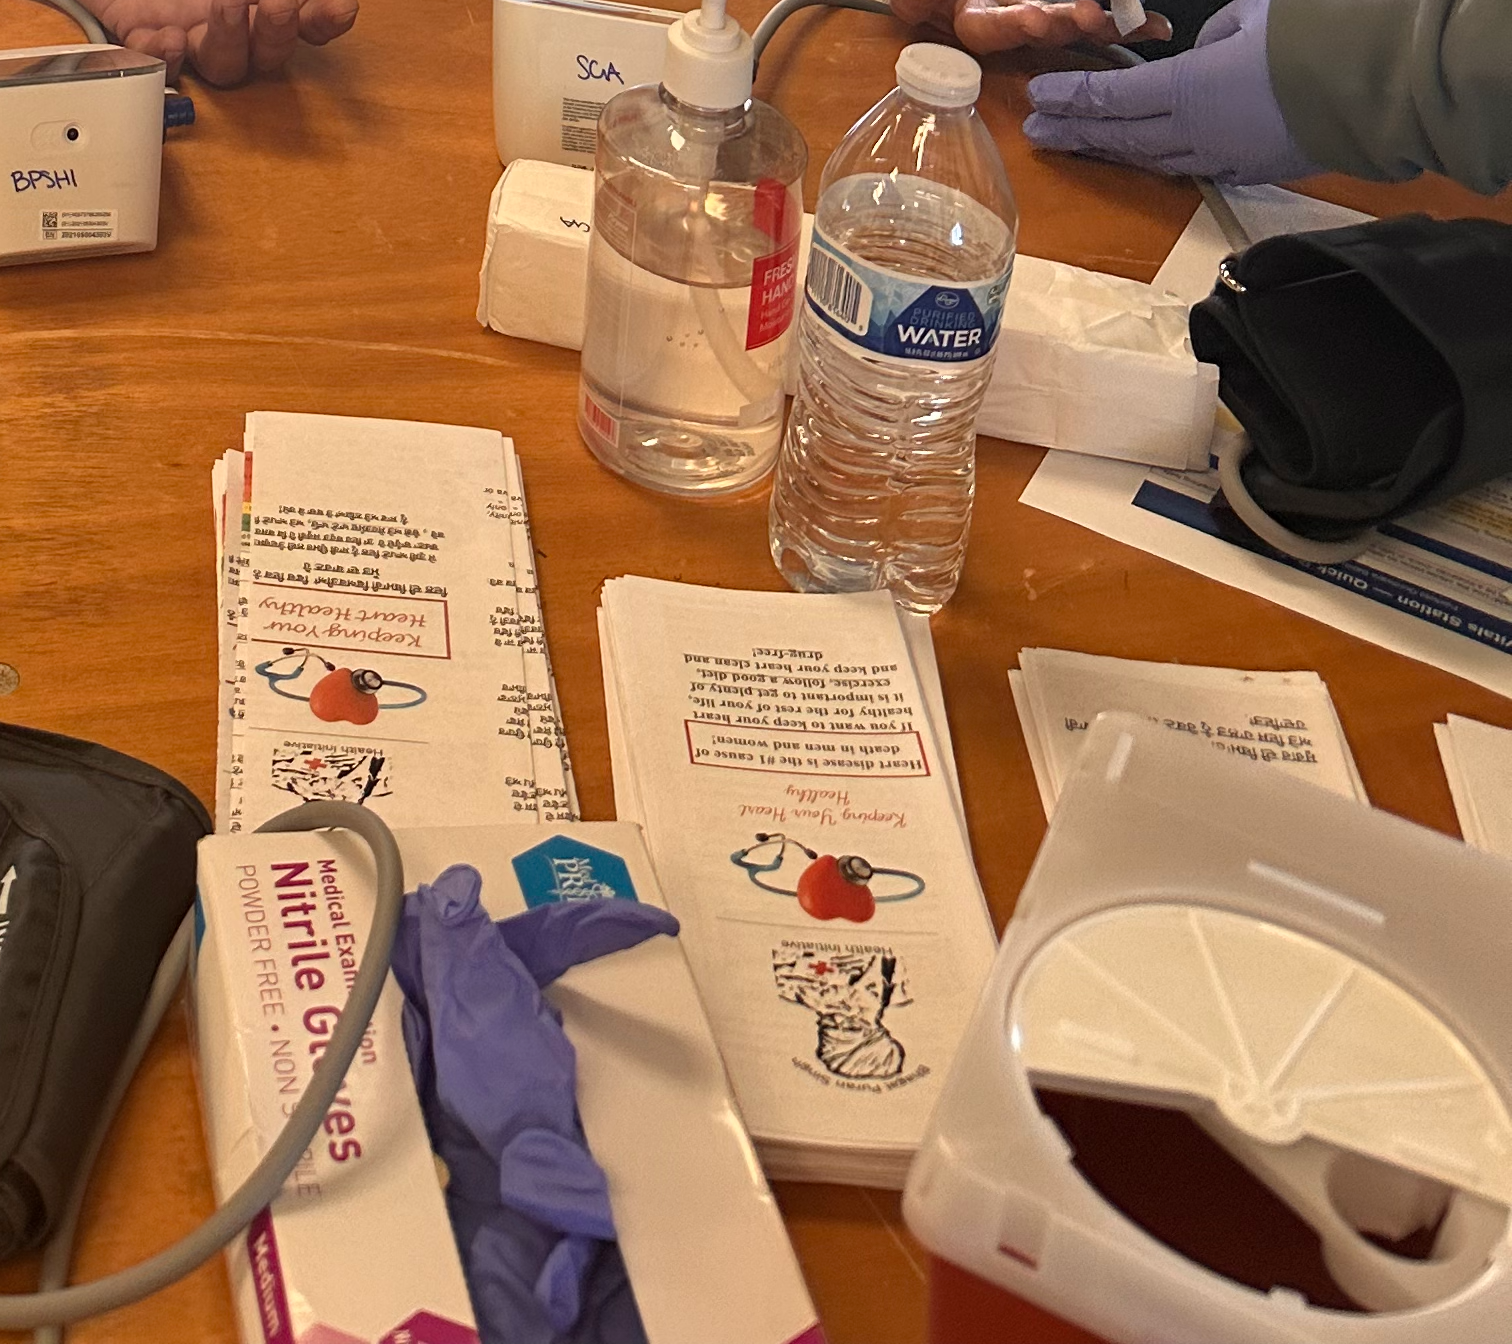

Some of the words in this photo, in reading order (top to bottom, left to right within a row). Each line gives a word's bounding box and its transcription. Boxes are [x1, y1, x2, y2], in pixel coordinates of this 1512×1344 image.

[913, 307, 976, 320] PURIFIED
[910, 317, 977, 329] DRINKING
[898, 325, 982, 348] WATER
[259, 597, 351, 620] Healthy
[1398, 596, 1462, 627] Station
[355, 610, 426, 627] Heart
[263, 622, 319, 638] Your
[322, 624, 421, 647] Keeping
[684, 655, 709, 663] and
[753, 649, 822, 661] drug-free!
[715, 658, 750, 668] clean
[756, 662, 792, 672] heart
[697, 669, 727, 680] diet,
[834, 665, 867, 675] keep
[872, 665, 897, 674] and
[732, 673, 766, 682] good
[691, 683, 704, 691] of
[783, 678, 825, 688] follow
[830, 679, 890, 689] exercise,
[710, 683, 753, 696] plenty
[758, 689, 778, 697] get
[688, 696, 715, 707] life,
[801, 692, 872, 701] important
[878, 695, 889, 703] is
[894, 693, 903, 702] it
[720, 700, 753, 709] your
[757, 704, 770, 712] of
[807, 707, 828, 716] the
[834, 708, 854, 717] for
[860, 707, 912, 717] healthy
[693, 711, 730, 724] heart
[736, 716, 768, 724] your
[774, 717, 807, 730] keep
[870, 721, 896, 729] you
[902, 722, 912, 731] If
[284, 741, 336, 752] Initiative
[712, 736, 767, 747] women!
[773, 742, 800, 750] and
[341, 747, 383, 756] Health
[693, 749, 709, 757] of
[841, 746, 854, 754] in
[860, 746, 900, 755] death
[714, 751, 753, 760] cause
[760, 755, 774, 764] #1
[780, 757, 802, 766] the
[807, 759, 818, 768] is
[823, 760, 874, 770] disease
[880, 760, 921, 769] Heart
[786, 786, 850, 806] Healthy
[741, 805, 786, 822] Heart
[796, 804, 837, 825] Your
[843, 808, 906, 828] Keeping
[317, 860, 350, 928] Medical
[272, 863, 325, 990] Nitrile
[781, 940, 840, 952] Initiative
[846, 945, 892, 955] Health
[236, 865, 271, 951] POWDER
[254, 959, 284, 1015] FREE
[271, 1040, 302, 1094] NON
[251, 1231, 281, 1336] Medium
